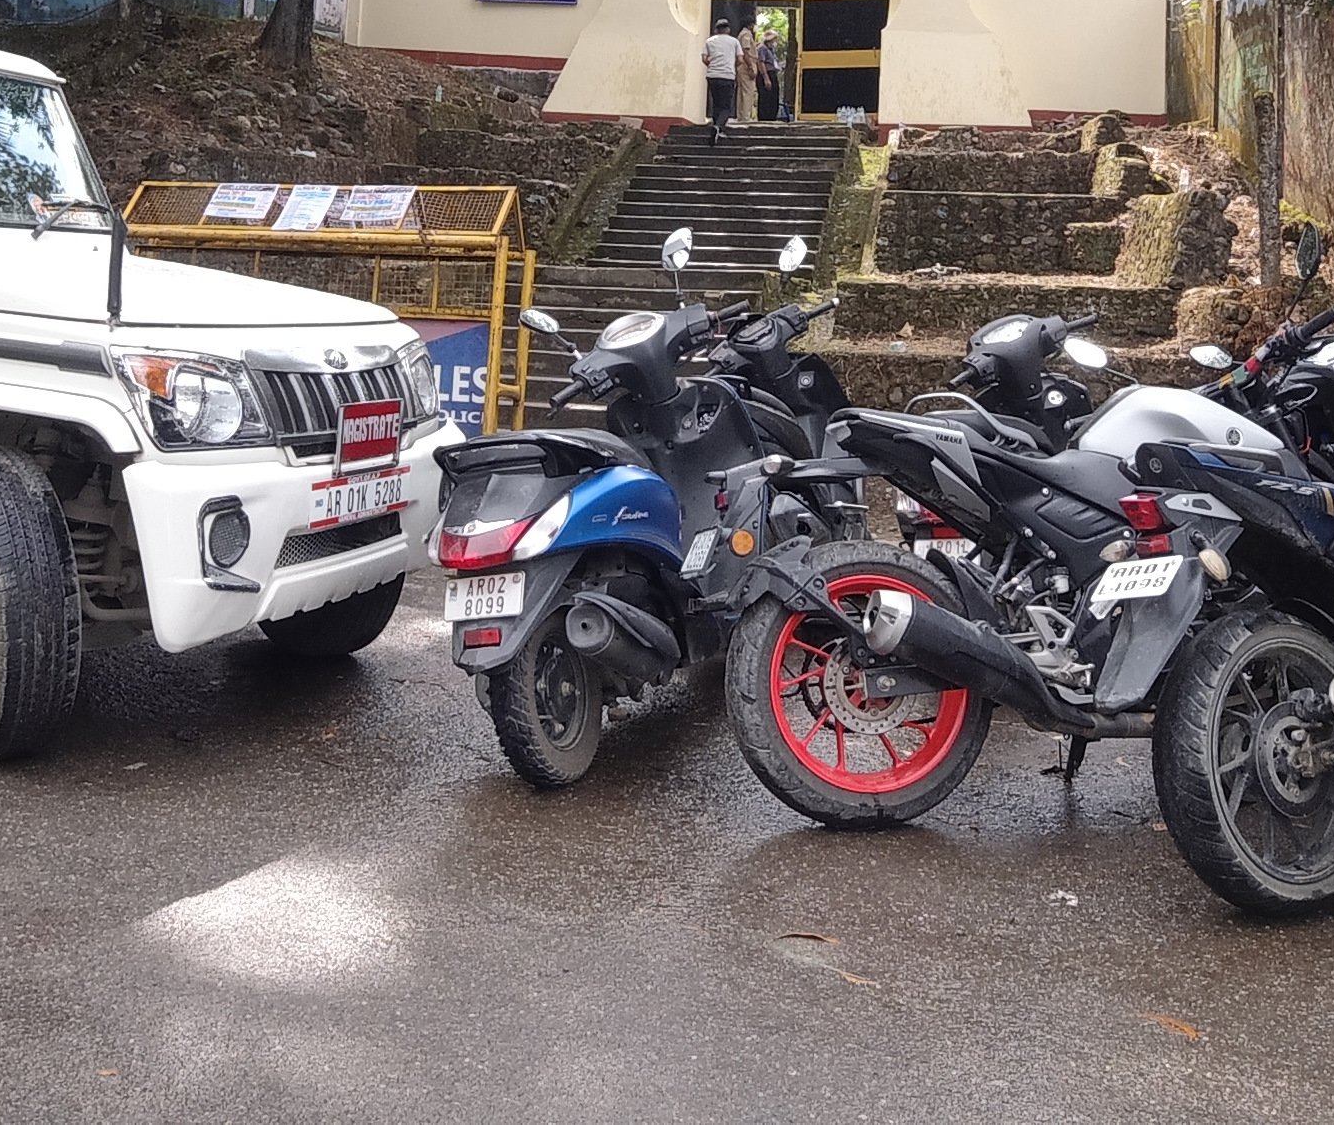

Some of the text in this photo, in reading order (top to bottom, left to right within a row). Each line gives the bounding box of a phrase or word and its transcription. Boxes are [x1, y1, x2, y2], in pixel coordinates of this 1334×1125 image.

[438, 409, 485, 424] OLIC
[342, 412, 401, 445] MAGISTRATE
[935, 433, 963, 445] YAMAHA
[326, 477, 402, 518] AR 01K 5288
[1113, 561, 1171, 578] AR01
[466, 576, 507, 597] AR02
[465, 595, 505, 616] 8099
